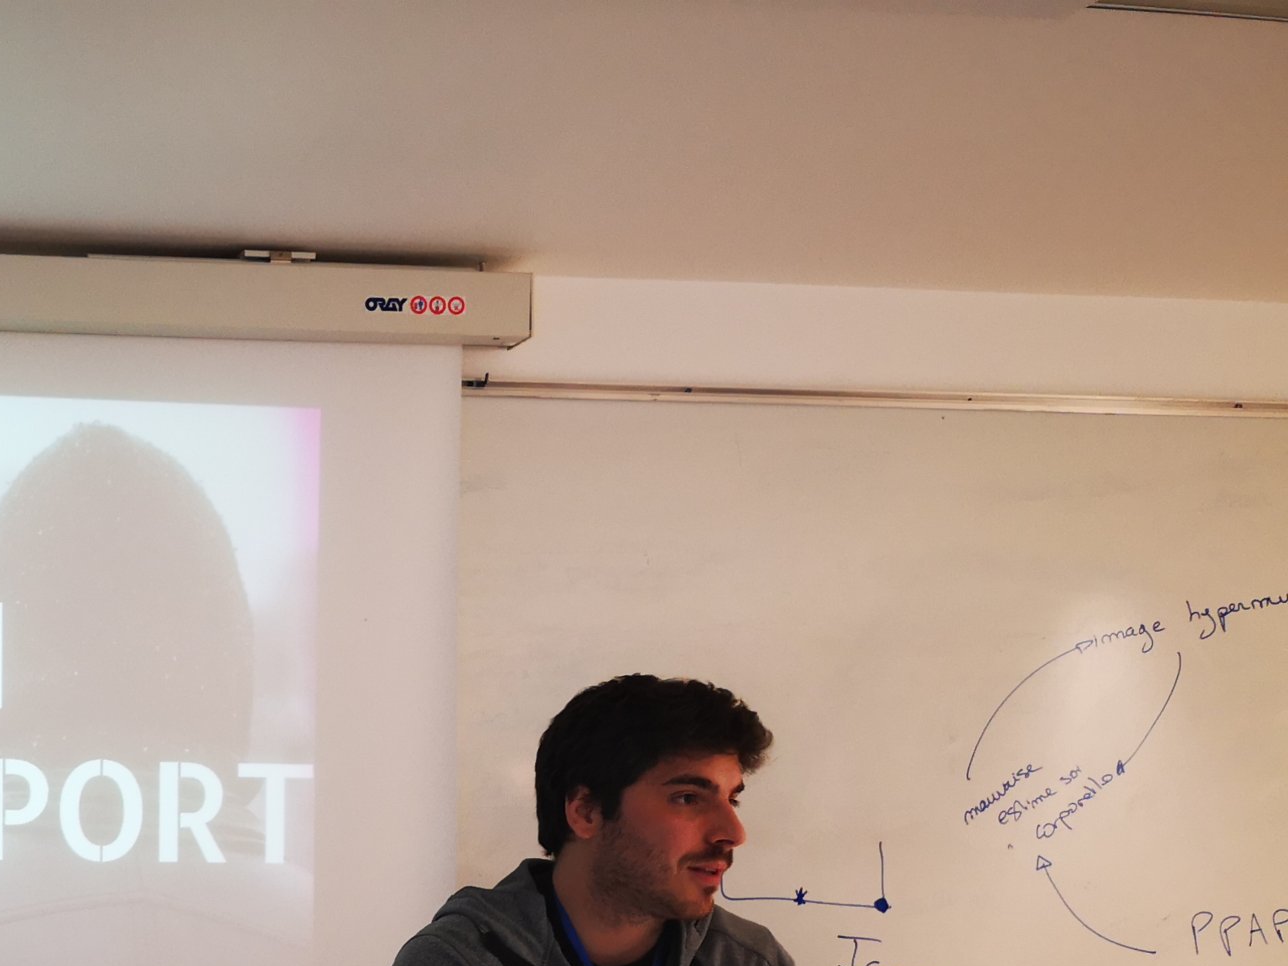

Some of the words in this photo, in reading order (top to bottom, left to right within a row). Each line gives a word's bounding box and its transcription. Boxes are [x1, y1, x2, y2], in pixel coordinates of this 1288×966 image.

[365, 297, 408, 312] ORAY
[1093, 620, 1165, 654] image
[964, 763, 1044, 826] mauvaise
[998, 787, 1058, 826] estime
